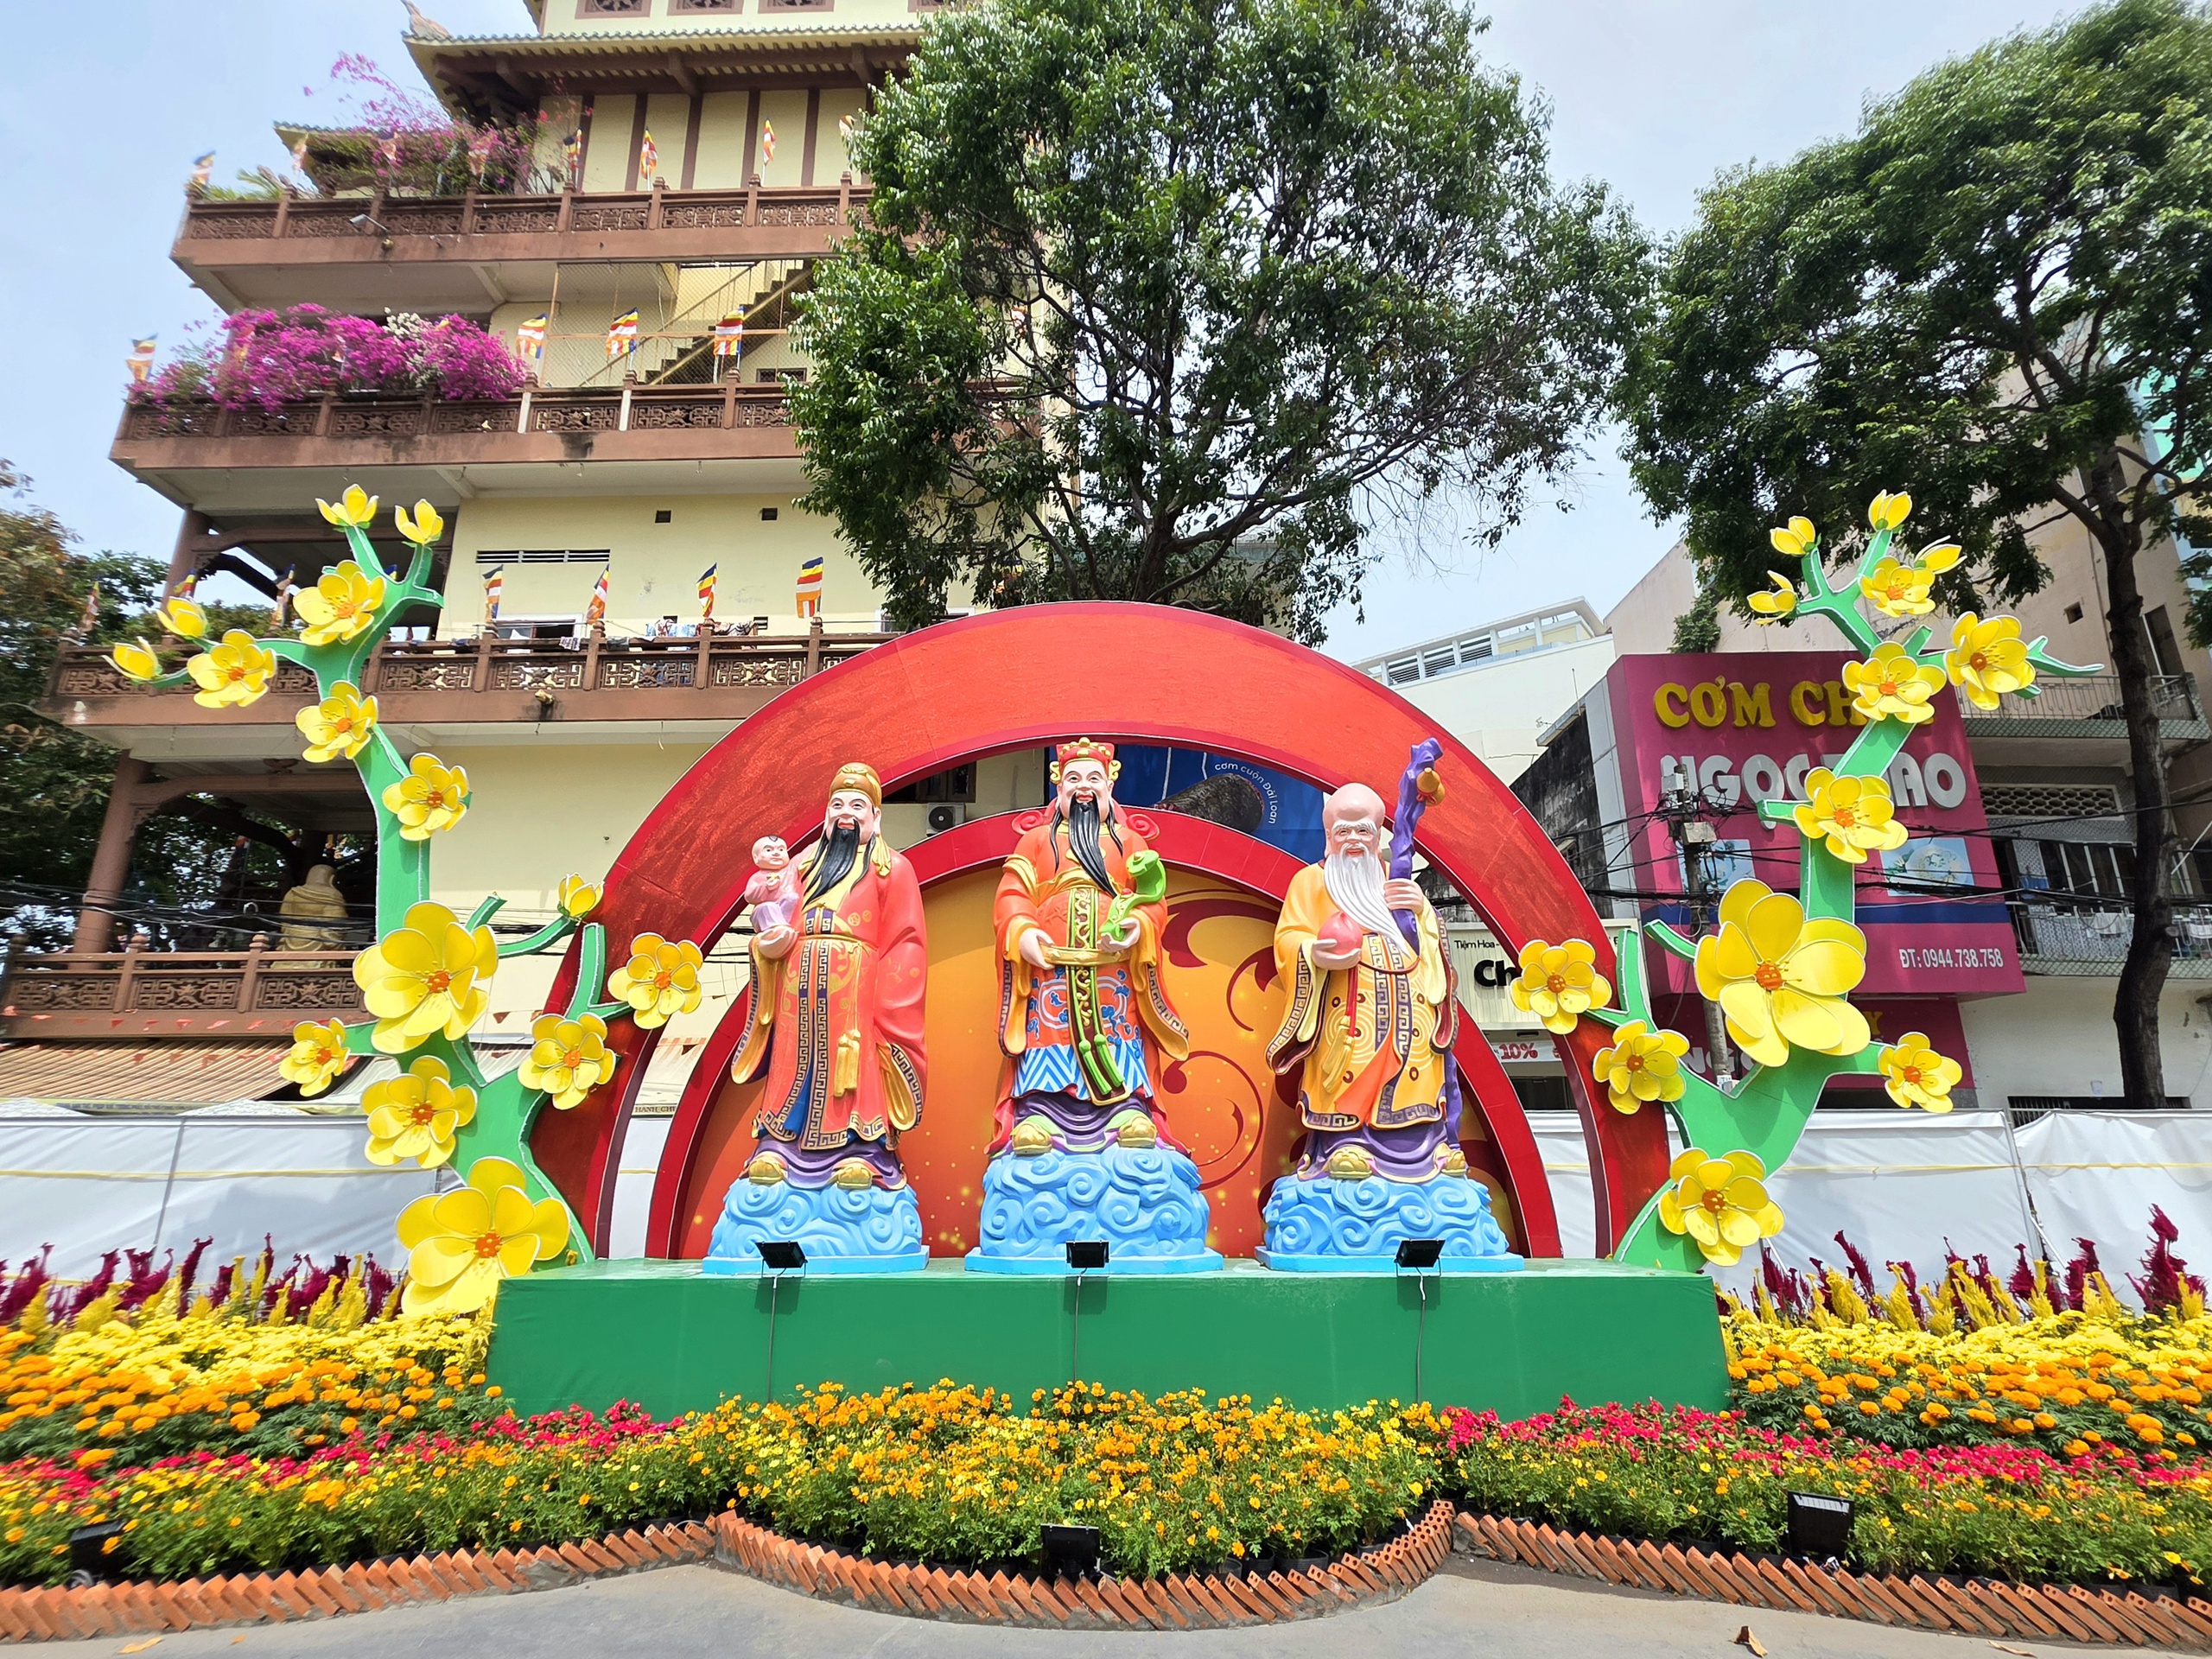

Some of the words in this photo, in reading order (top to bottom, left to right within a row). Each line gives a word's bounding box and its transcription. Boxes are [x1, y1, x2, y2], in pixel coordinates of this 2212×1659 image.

[1654, 675, 1776, 728] CƠM
[1214, 762, 1238, 771] cơm
[1240, 766, 1264, 784] cuộn
[1268, 800, 1278, 824] Loan
[1453, 939, 1477, 950] Tiệm
[1477, 939, 1496, 949] Hoa
[1898, 948, 1922, 968] ĐT:
[1922, 948, 2004, 968] 0944.738.758
[1498, 1042, 1538, 1059] 10%
